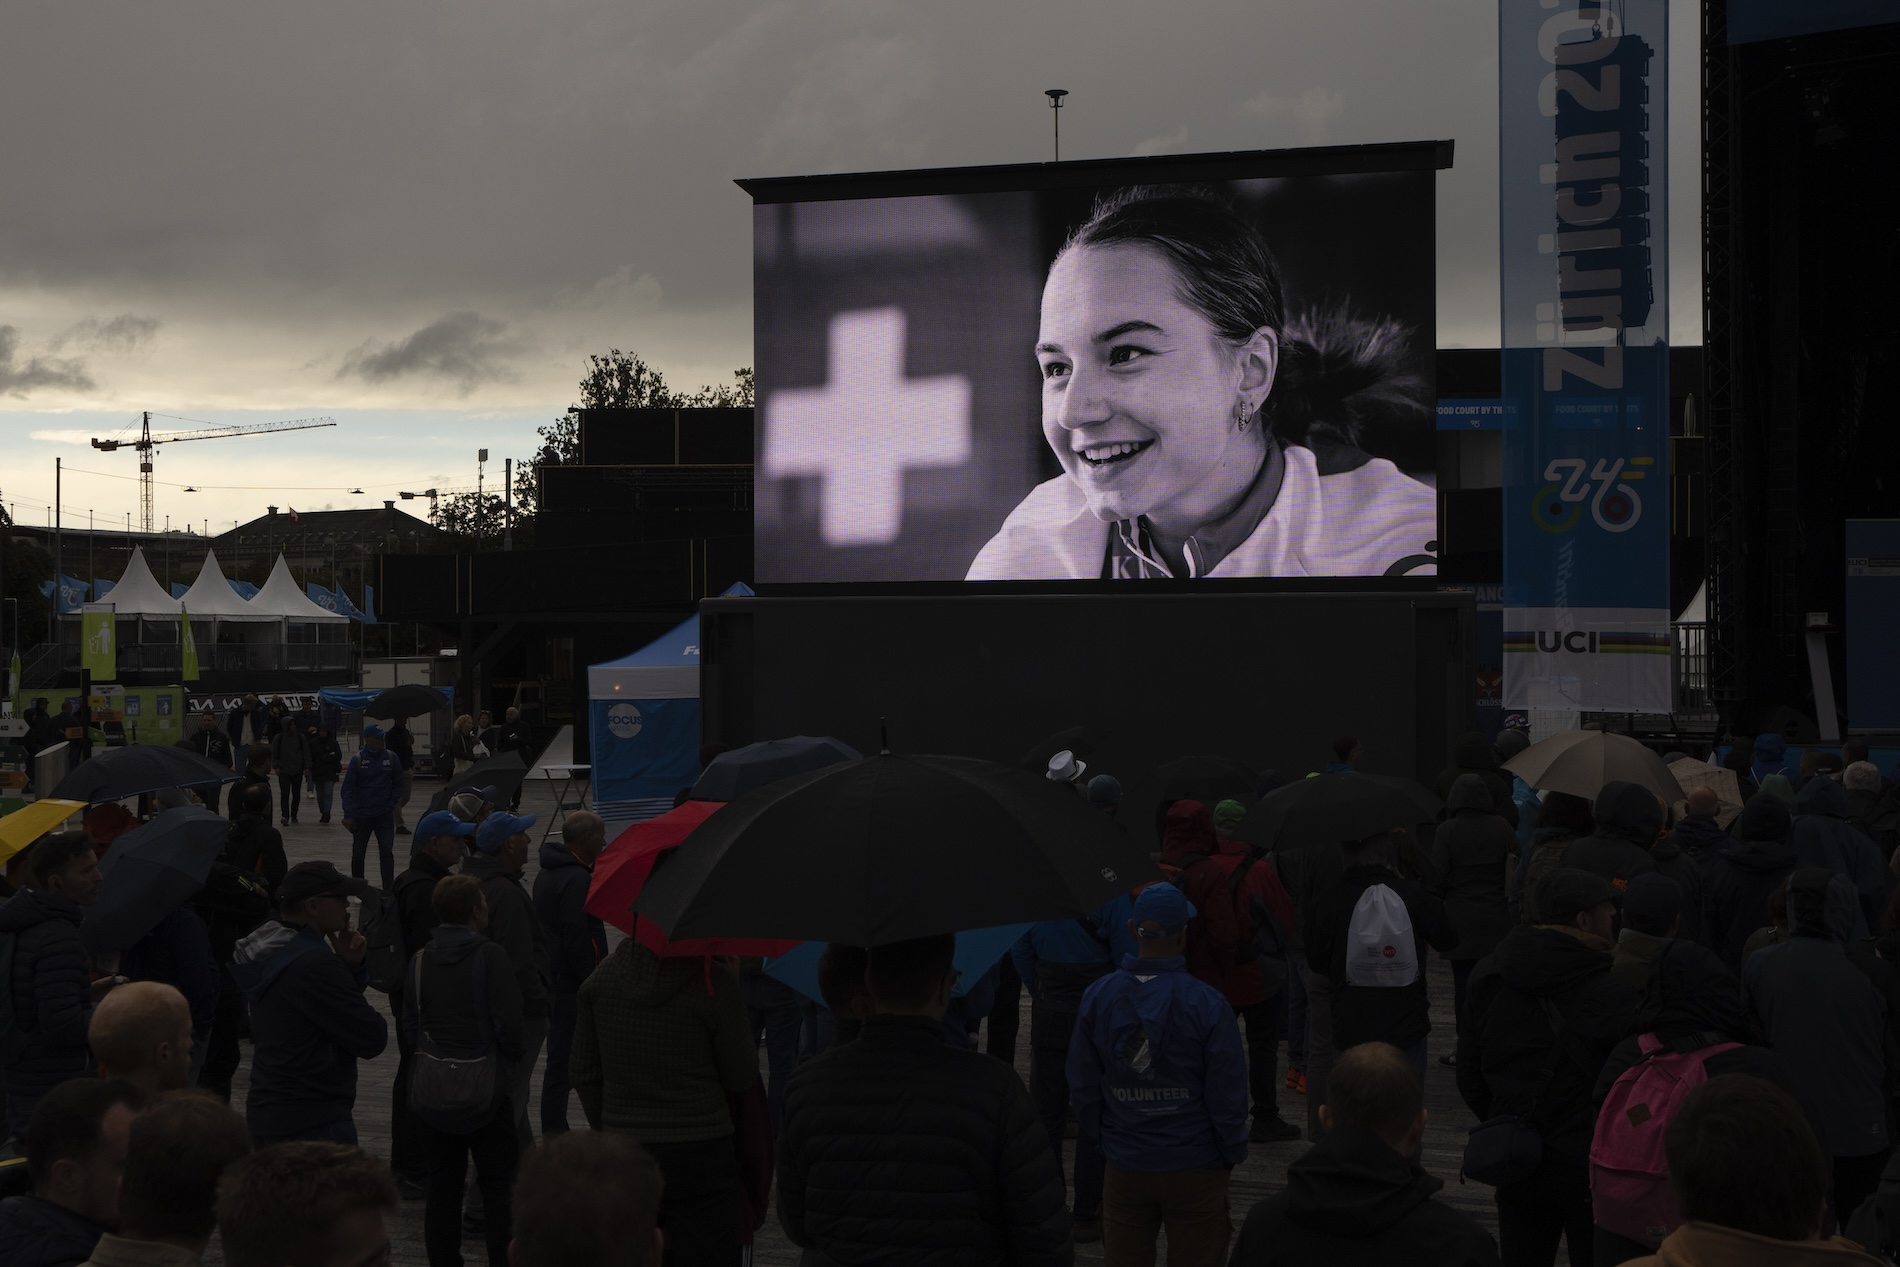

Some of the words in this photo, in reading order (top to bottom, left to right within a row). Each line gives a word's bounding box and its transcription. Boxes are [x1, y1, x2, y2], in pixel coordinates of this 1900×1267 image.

[1538, 0, 1621, 117] 20
[1536, 131, 1624, 392] Zürich
[1455, 406, 1480, 415] COURT
[1481, 406, 1491, 415] BY
[1577, 405, 1602, 413] COURT
[1538, 631, 1597, 653] UCI
[608, 715, 643, 725] FOCUS
[1110, 1085, 1190, 1102] VOLUNTEER
